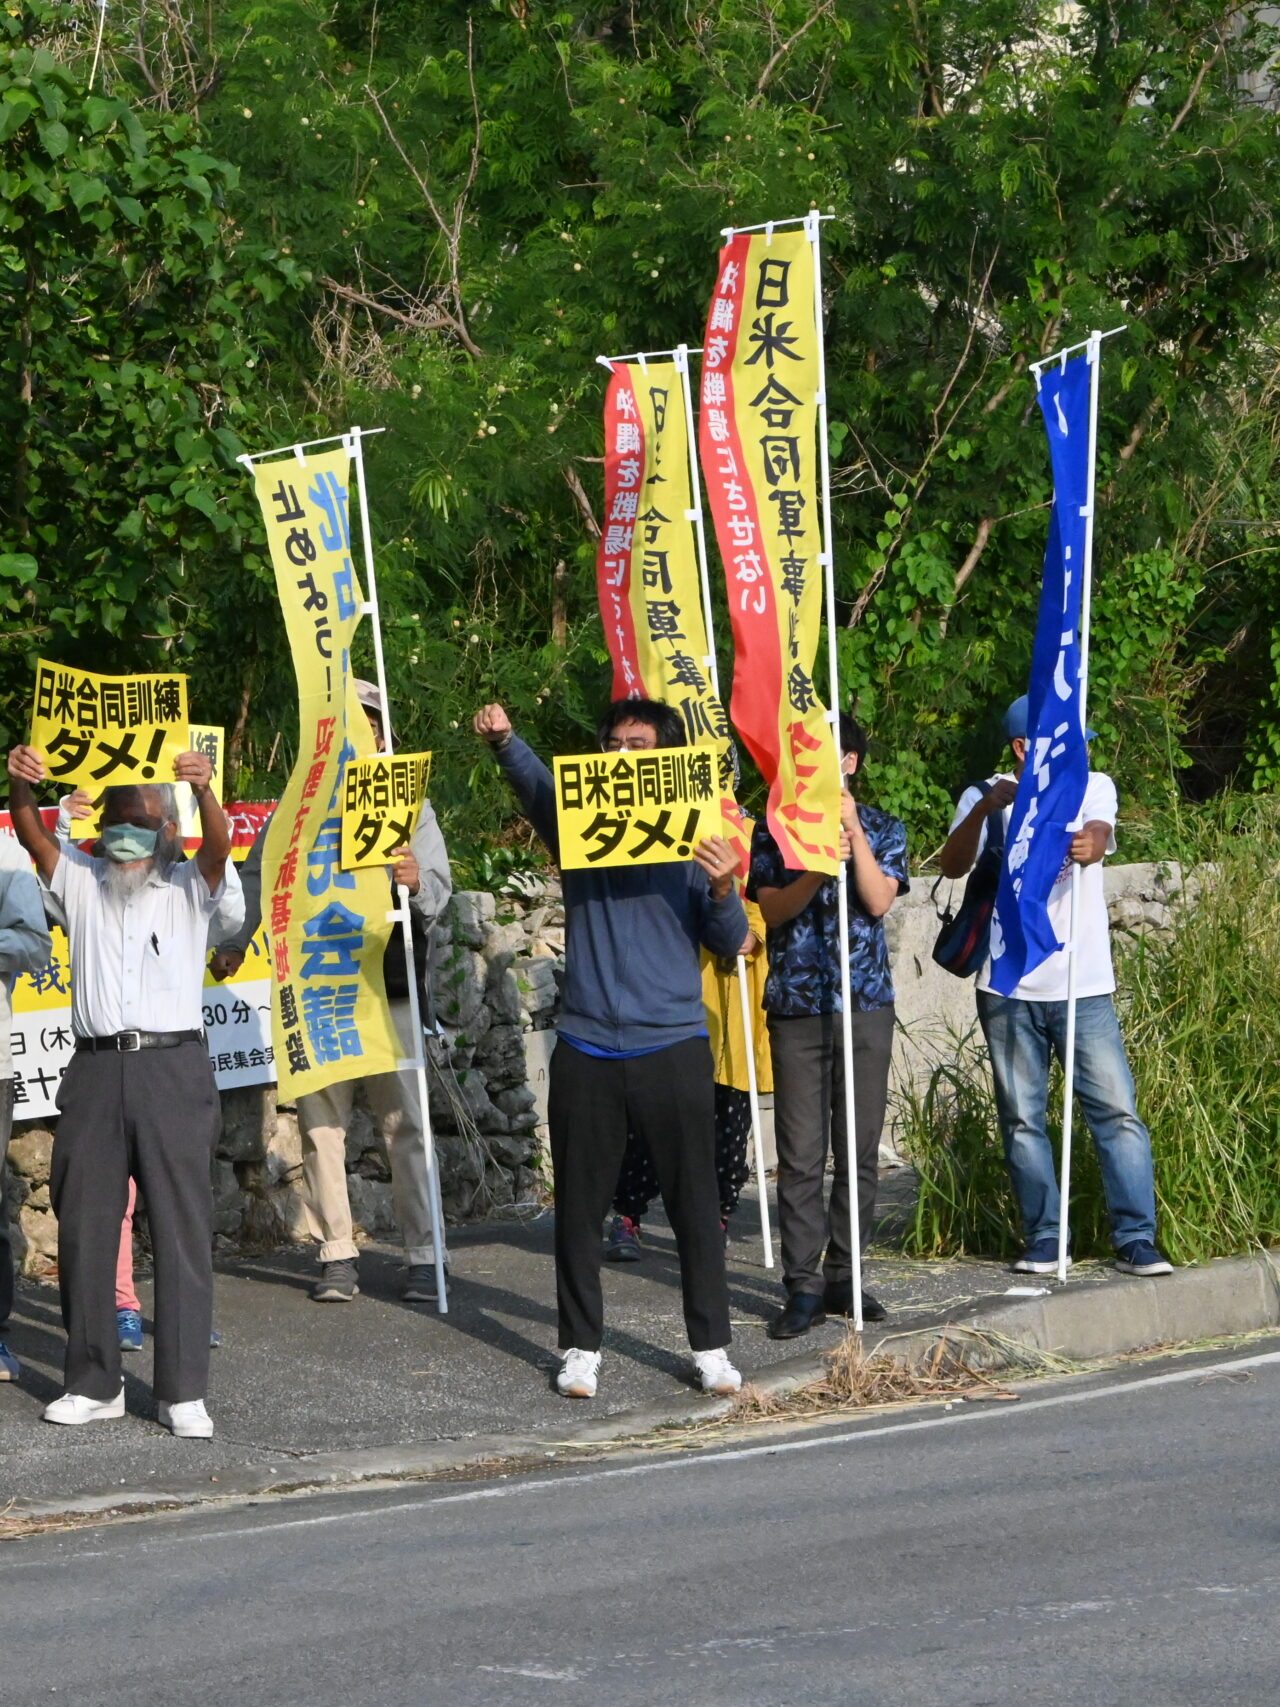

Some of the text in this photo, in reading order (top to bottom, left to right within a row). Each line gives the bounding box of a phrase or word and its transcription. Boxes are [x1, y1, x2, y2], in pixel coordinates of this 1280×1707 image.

[35, 667, 182, 730] 日米合同訓練
[45, 728, 167, 780] ダメ!
[559, 751, 714, 811] 日米合同訓練
[581, 808, 700, 862] ダメ!
